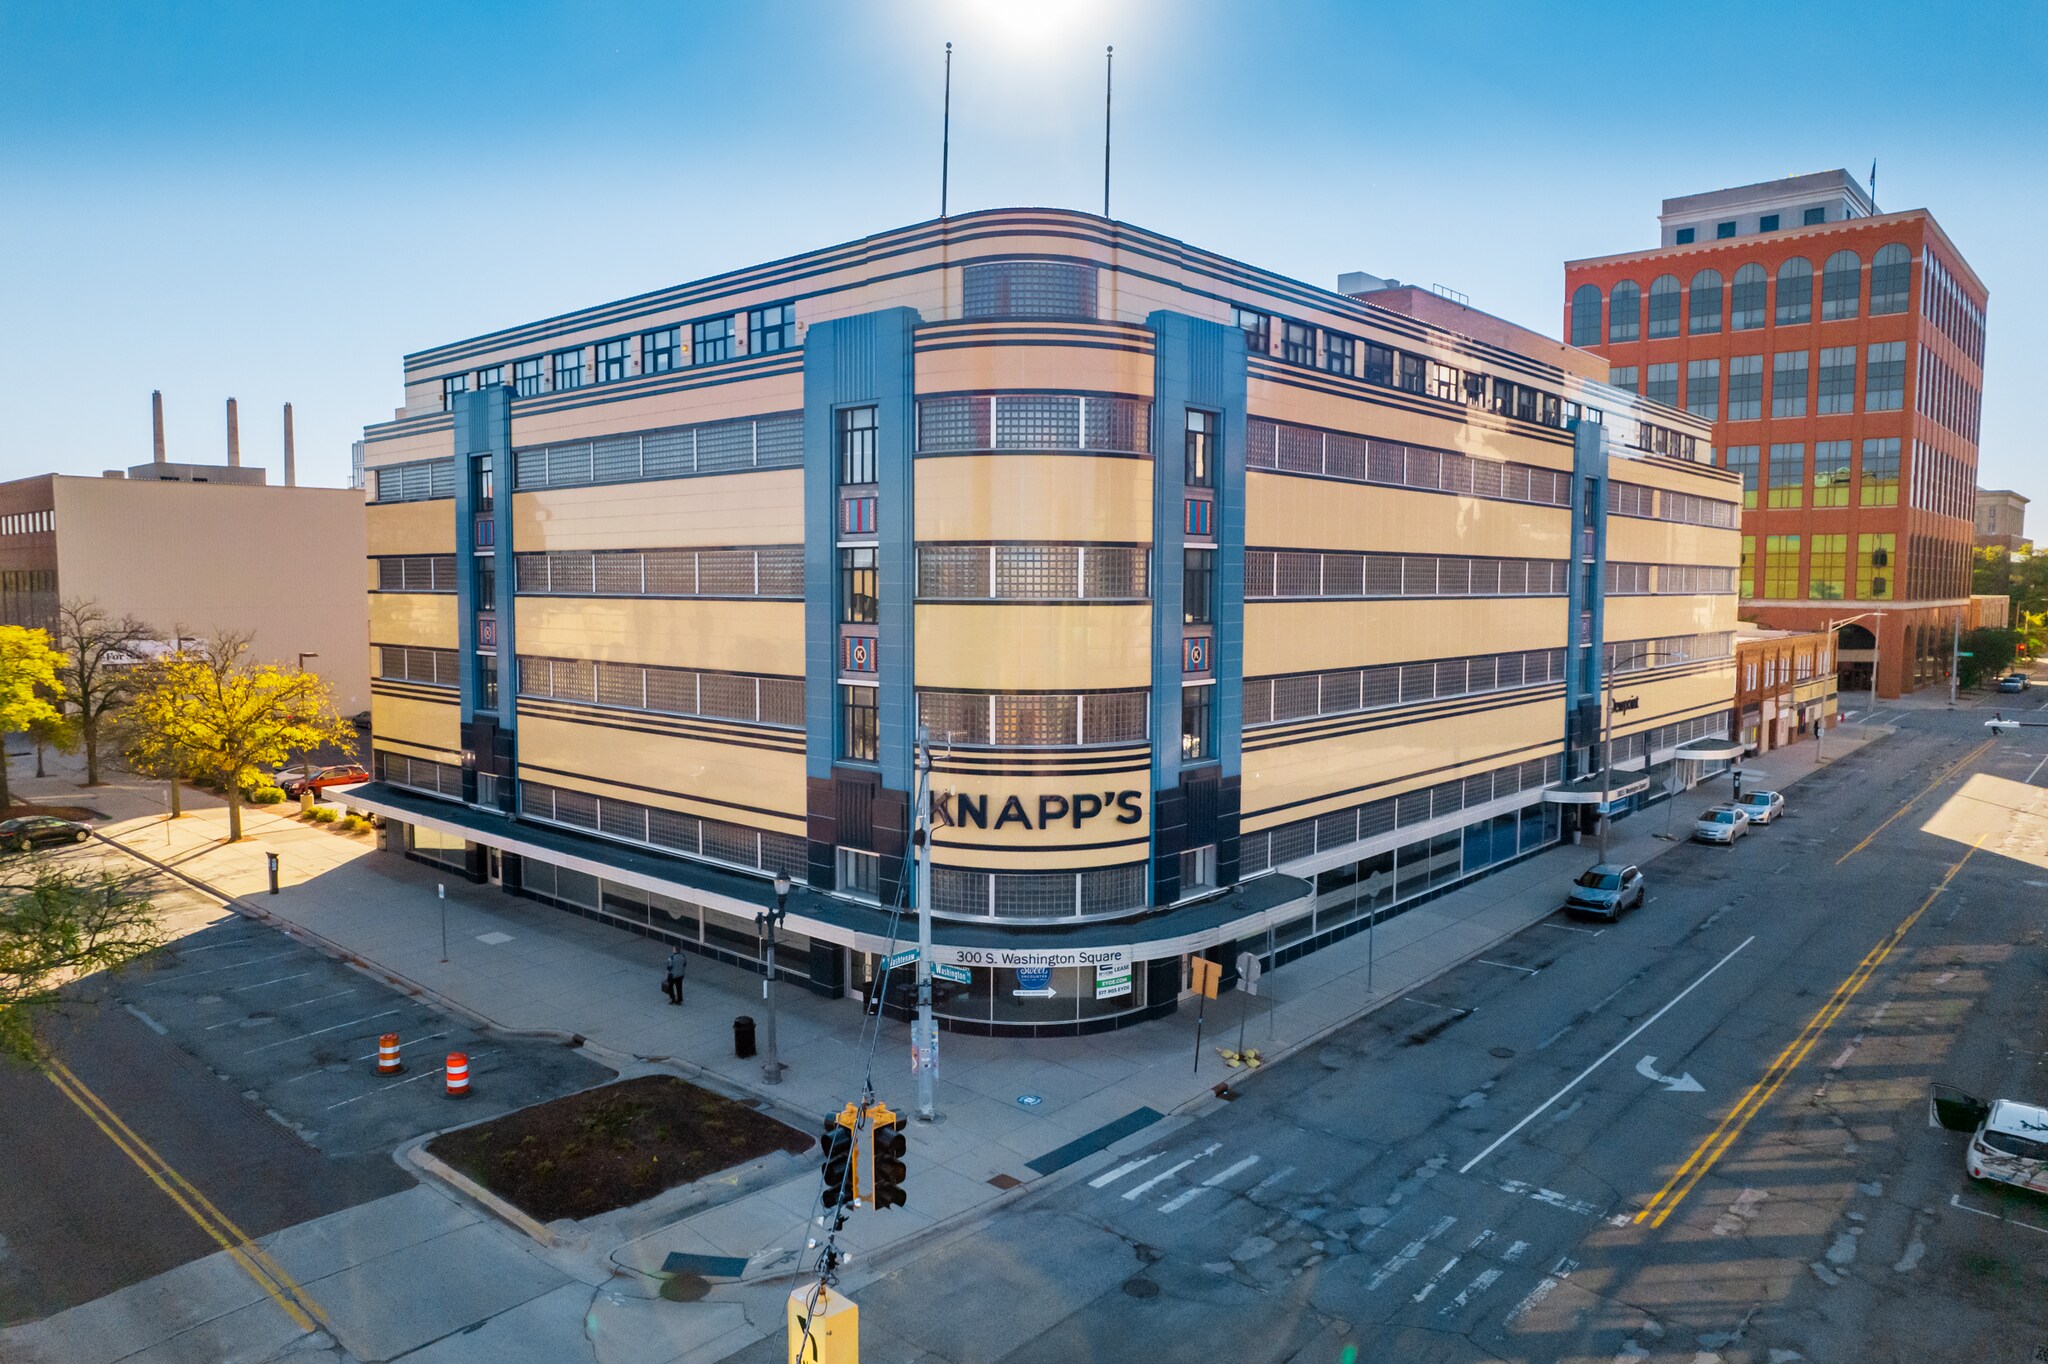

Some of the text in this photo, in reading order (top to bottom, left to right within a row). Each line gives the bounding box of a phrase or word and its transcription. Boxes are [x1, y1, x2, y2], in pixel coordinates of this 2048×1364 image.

[106, 653, 125, 661] For
[857, 650, 863, 659] K
[930, 789, 1142, 830] KNAPP'S
[956, 951, 1122, 967] 300 S. Washington Square
[936, 963, 966, 980] Washington
[1114, 964, 1130, 972] LEASE
[1101, 977, 1127, 987] EYDE.COM
